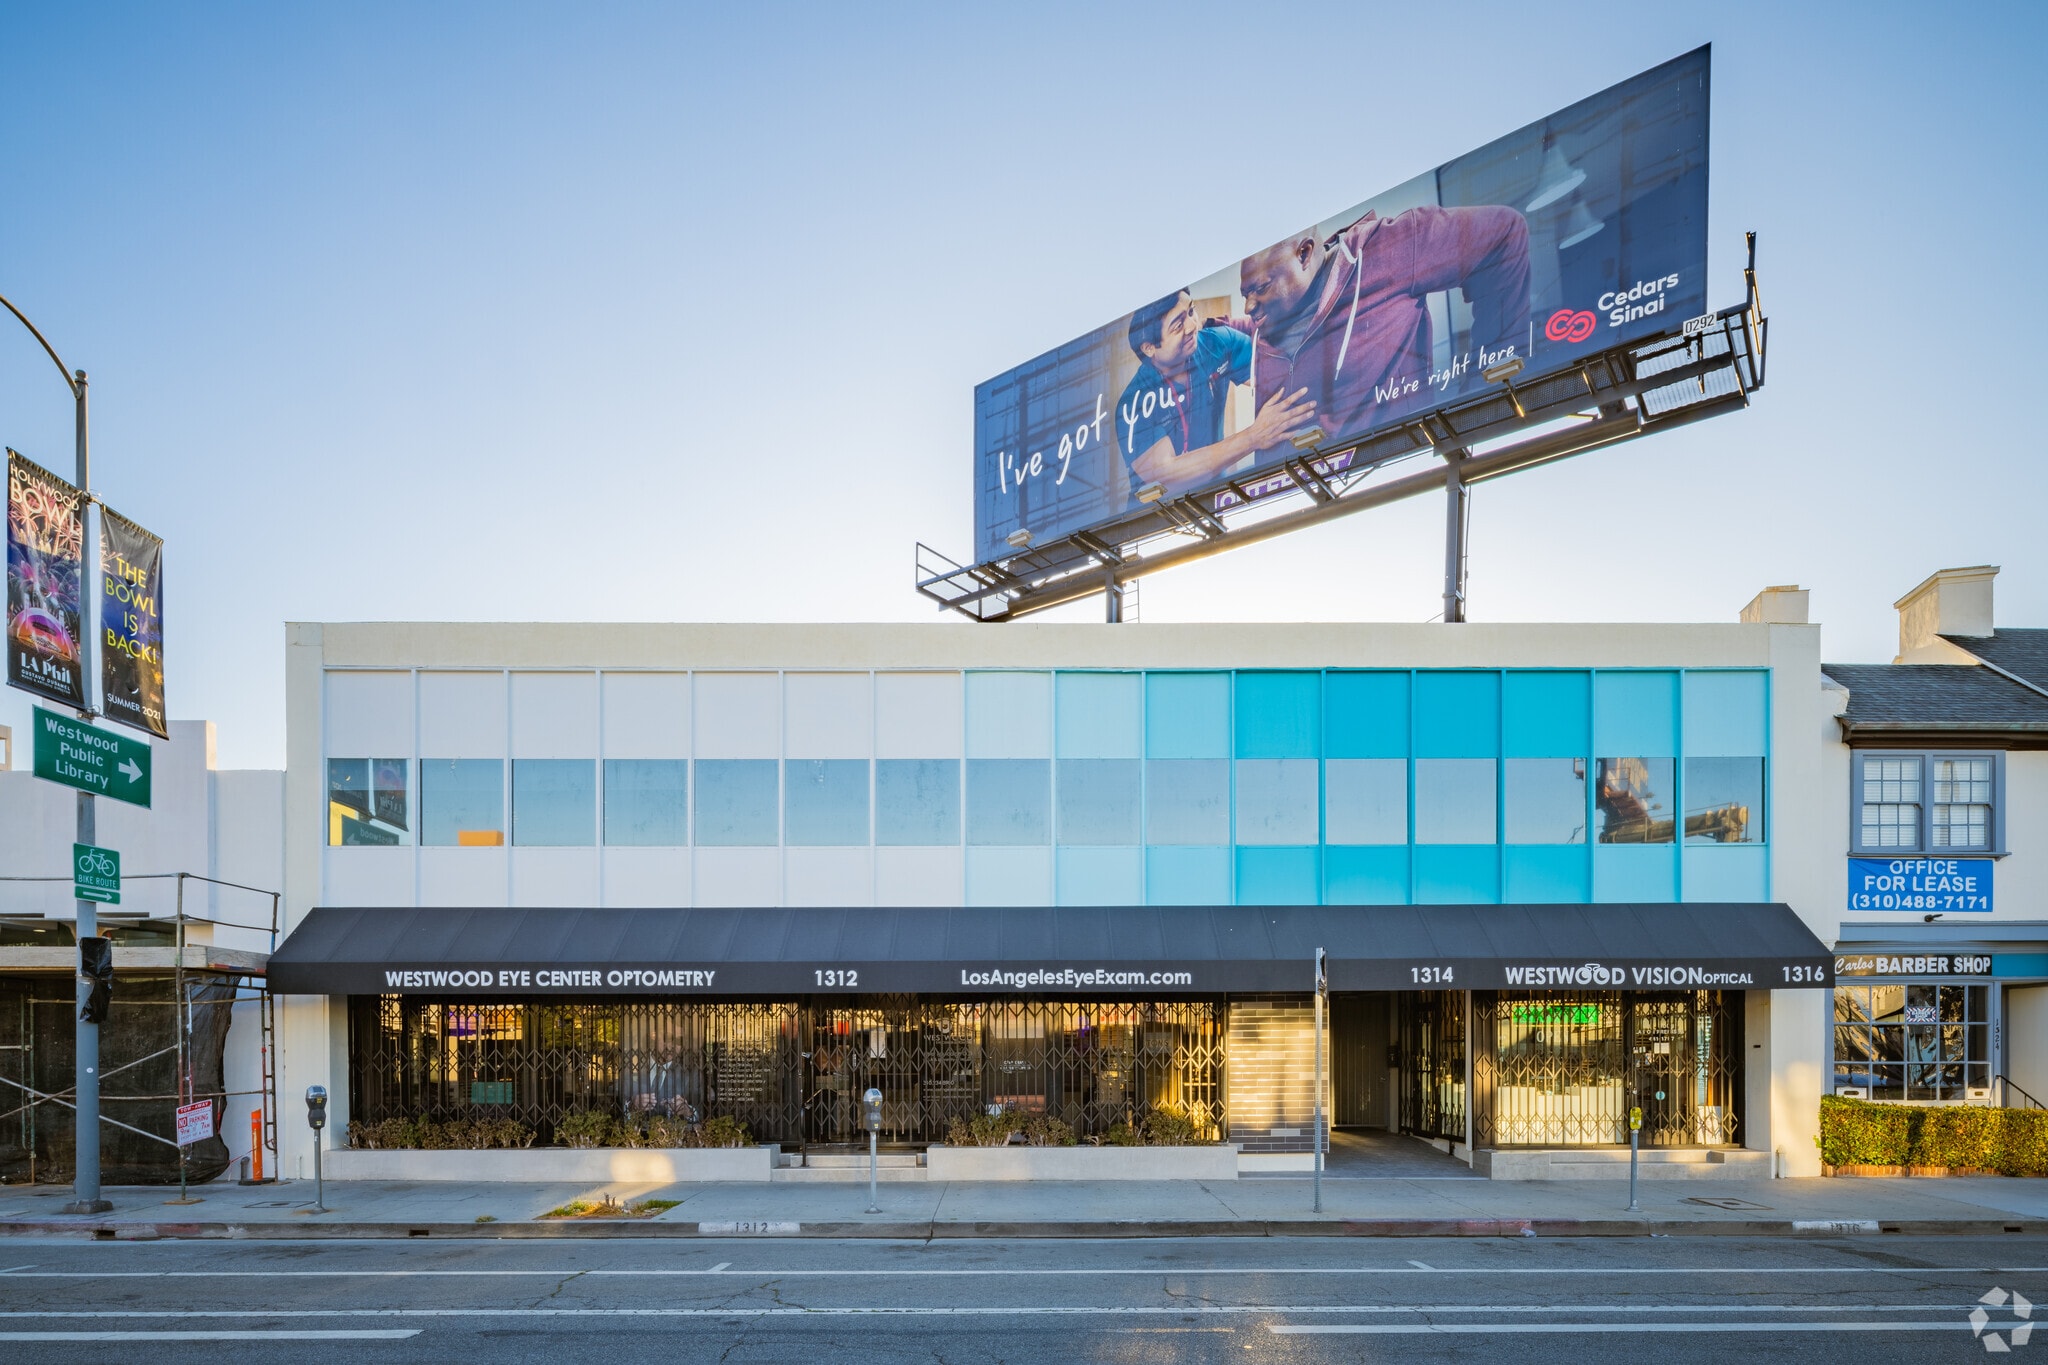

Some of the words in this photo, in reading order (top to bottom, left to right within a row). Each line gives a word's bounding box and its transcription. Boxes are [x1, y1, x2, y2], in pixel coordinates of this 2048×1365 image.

[1598, 272, 1679, 311] Cedars
[1609, 293, 1665, 328] Sinai
[1684, 315, 1716, 336] 0292
[1374, 376, 1419, 404] We're
[1428, 355, 1471, 392] right
[1000, 450, 1043, 494] I've
[1055, 393, 1108, 485] got
[1122, 387, 1186, 454] you.
[10, 463, 80, 511] HOLLYWOOD
[10, 477, 82, 537] BOWL
[116, 557, 147, 589] THE
[105, 576, 157, 618] BOWL
[123, 611, 138, 633] IS
[107, 627, 158, 665] BACK!
[21, 652, 40, 673] LA
[42, 660, 71, 684] Phil
[107, 692, 141, 714] SUMMER
[141, 705, 162, 720] 2021
[45, 717, 119, 754] Westwood
[60, 741, 104, 767] Public
[55, 759, 109, 790] Library
[1889, 860, 1958, 875] OFFICE
[78, 874, 94, 884] BIKE
[95, 876, 117, 888] ROUTE
[1864, 875, 1906, 892] FOR
[1912, 876, 1977, 892] LEASE
[1852, 893, 1988, 910] (310)488-7171
[1411, 966, 1454, 984] 1314
[1505, 966, 1626, 985] WESTWOOD
[1783, 965, 1825, 983] 1316
[1834, 958, 1875, 975] Carlos
[1876, 956, 1949, 974] BARBER
[1953, 956, 1991, 974] SHOP
[385, 970, 493, 987] WESTWOOD
[499, 970, 530, 987] EYE
[536, 970, 602, 987] CENTER
[607, 970, 716, 987] OPTOMETRY
[814, 969, 858, 987] 1312
[961, 969, 1193, 989] LosAngelesEyeExam.com
[178, 1117, 188, 1128] NO
[735, 1222, 769, 1234] 1312
